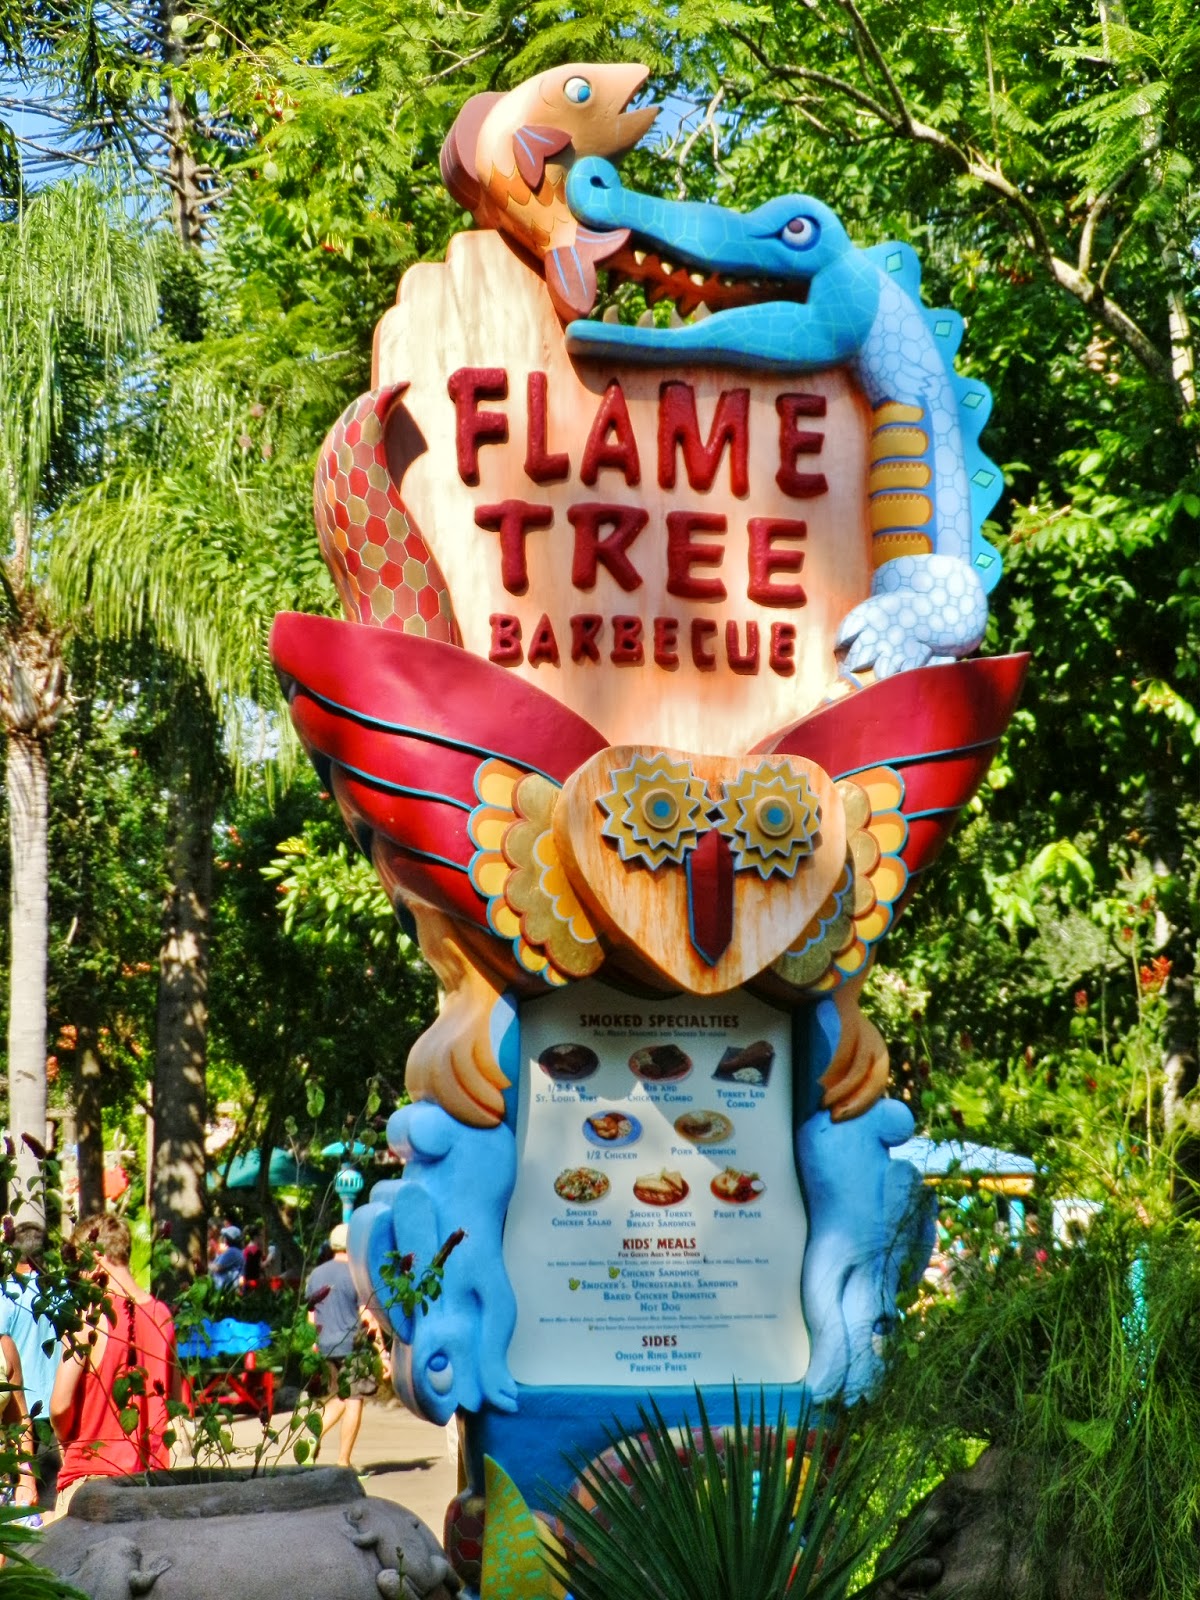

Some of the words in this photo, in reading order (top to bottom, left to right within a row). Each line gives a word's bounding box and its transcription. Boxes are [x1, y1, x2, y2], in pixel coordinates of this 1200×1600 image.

[447, 367, 829, 498] FLAME
[474, 499, 808, 607] TREE
[488, 612, 797, 676] BARBECUE
[579, 1013, 643, 1028] SMOKED
[648, 1014, 740, 1029] SPECIALTIES
[663, 1093, 693, 1103] COMBO
[716, 1088, 746, 1099] TURKEY
[749, 1089, 766, 1099] LEG
[726, 1099, 756, 1109] COMBO
[586, 1150, 601, 1160] 1/2
[604, 1151, 638, 1160] CHICKEN
[697, 1146, 737, 1156] SANDWICH
[566, 1208, 598, 1217] SMOKED
[713, 1209, 737, 1219] FRUIT
[739, 1209, 762, 1219] PLATE
[551, 1218, 584, 1227] CHICKEN
[586, 1217, 612, 1227] SALAD
[622, 1237, 652, 1250] KIDS'
[657, 1238, 697, 1250] MEALS
[620, 1268, 656, 1278] CHICKEN
[658, 1268, 700, 1278] SANDWICH
[697, 1279, 738, 1288] SANDWICH
[603, 1291, 632, 1301] BAKED
[634, 1291, 668, 1300] CHICKEN
[640, 1302, 658, 1312] HOT
[661, 1302, 681, 1312] DOG
[641, 1335, 678, 1347] SIDES
[615, 1351, 644, 1361] ONION
[671, 1350, 702, 1360] BASKET
